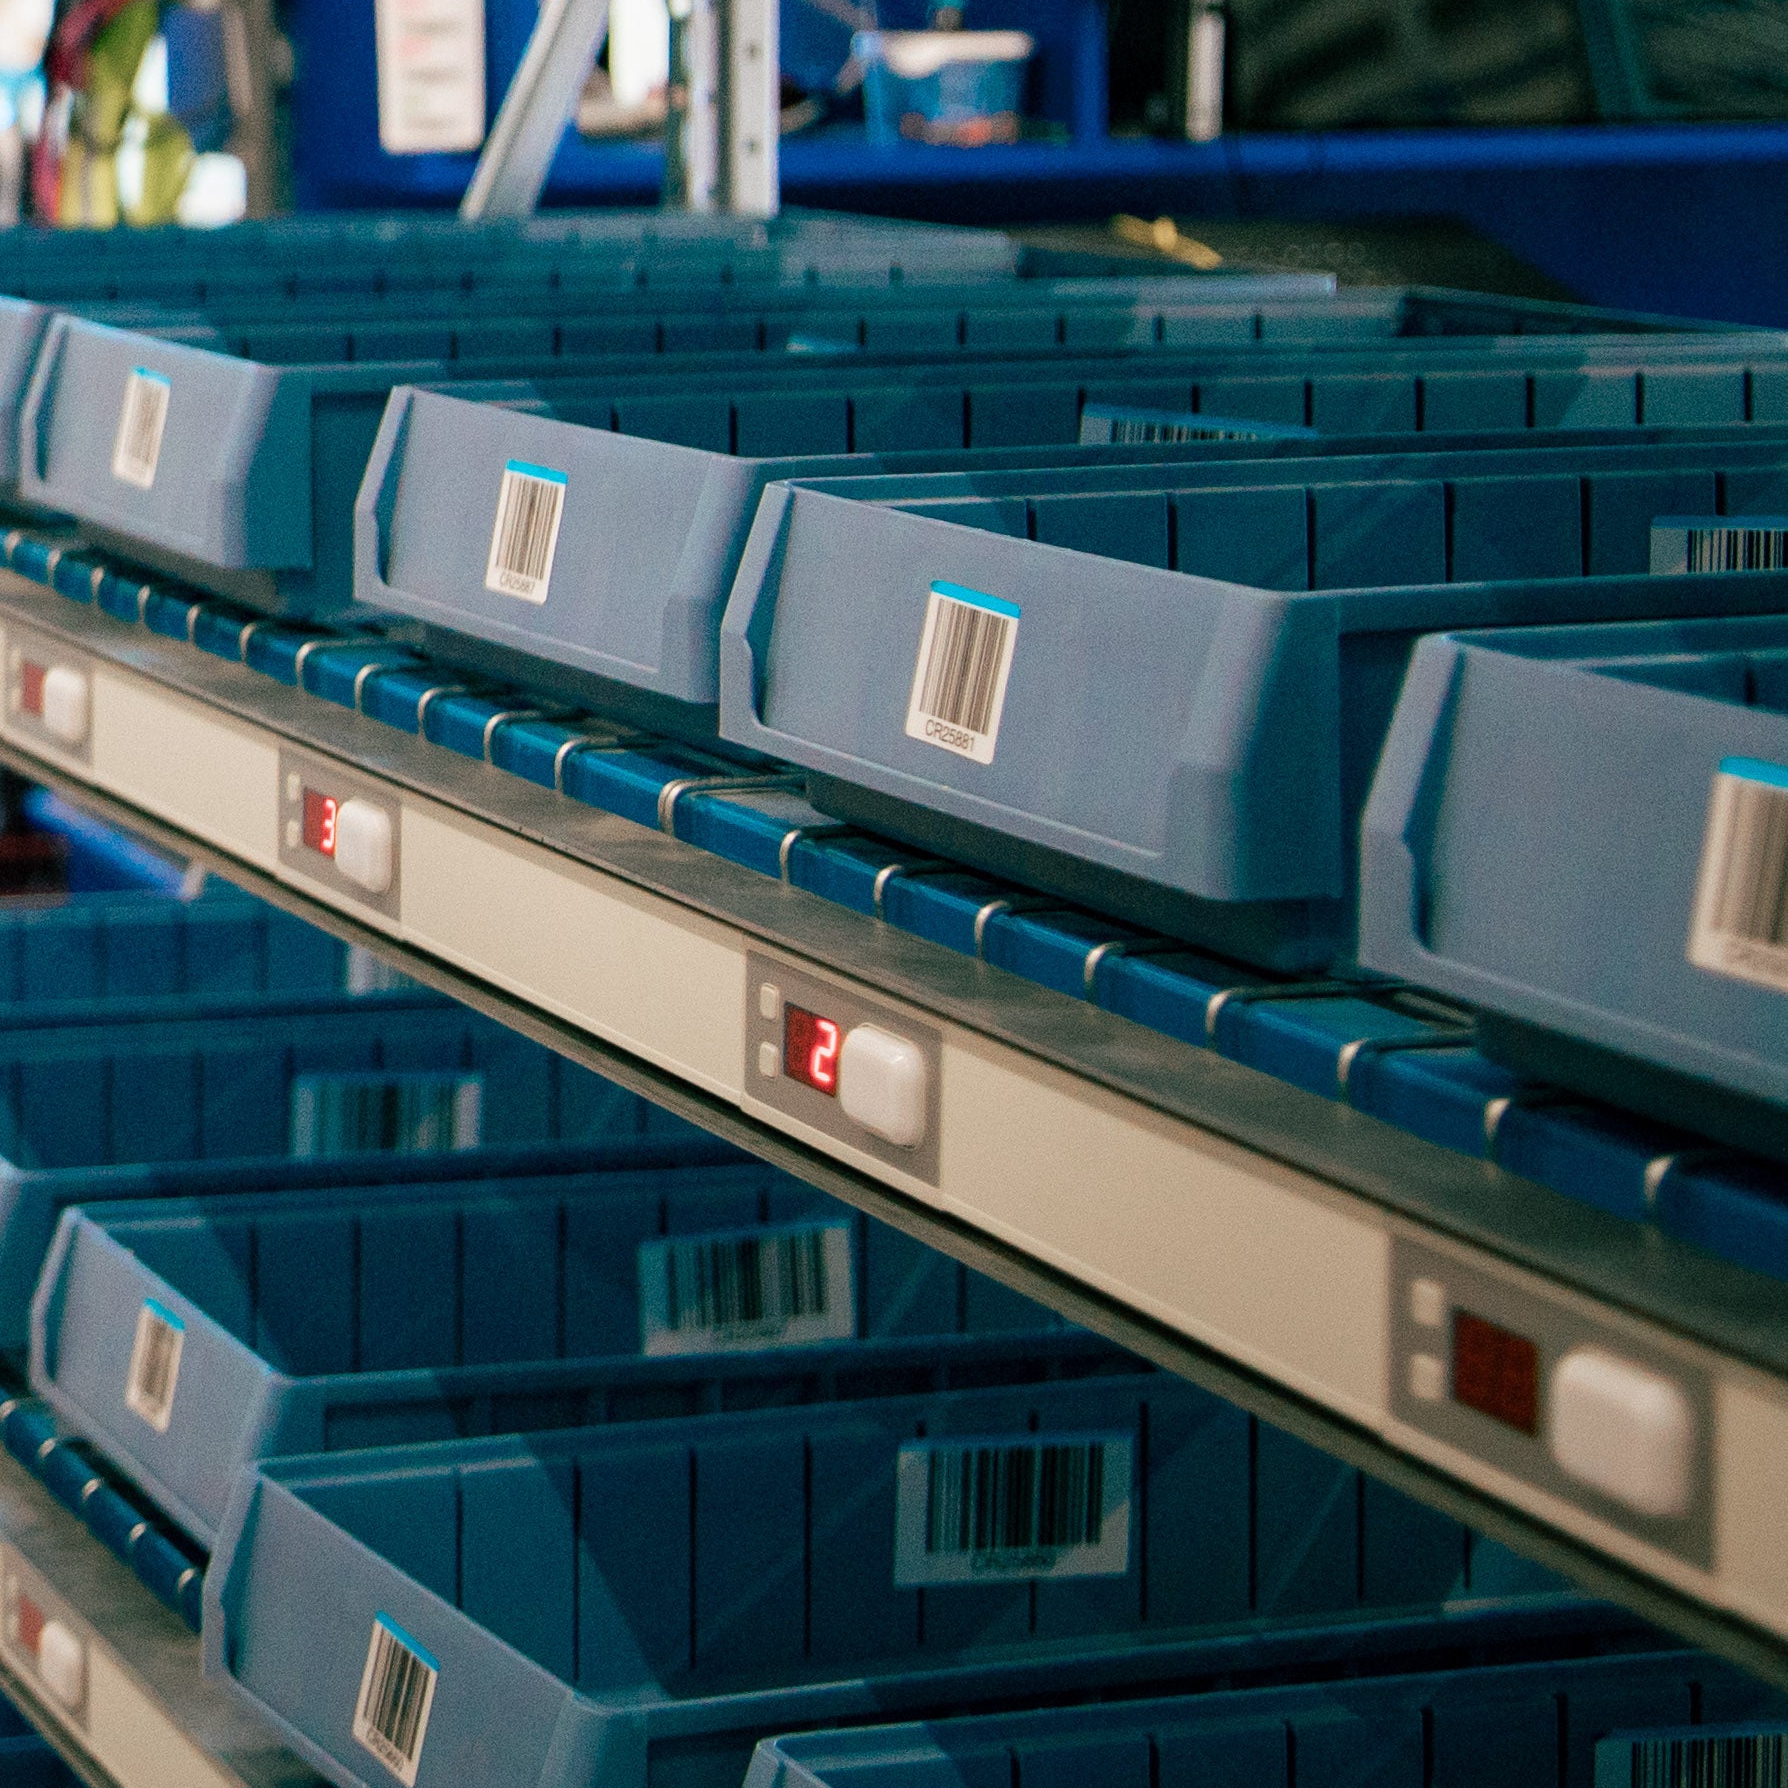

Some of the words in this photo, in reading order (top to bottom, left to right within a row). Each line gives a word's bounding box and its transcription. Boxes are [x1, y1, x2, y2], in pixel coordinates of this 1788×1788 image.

[925, 719, 975, 752] CR25881
[322, 798, 337, 849] 3
[811, 1018, 838, 1083] 2
